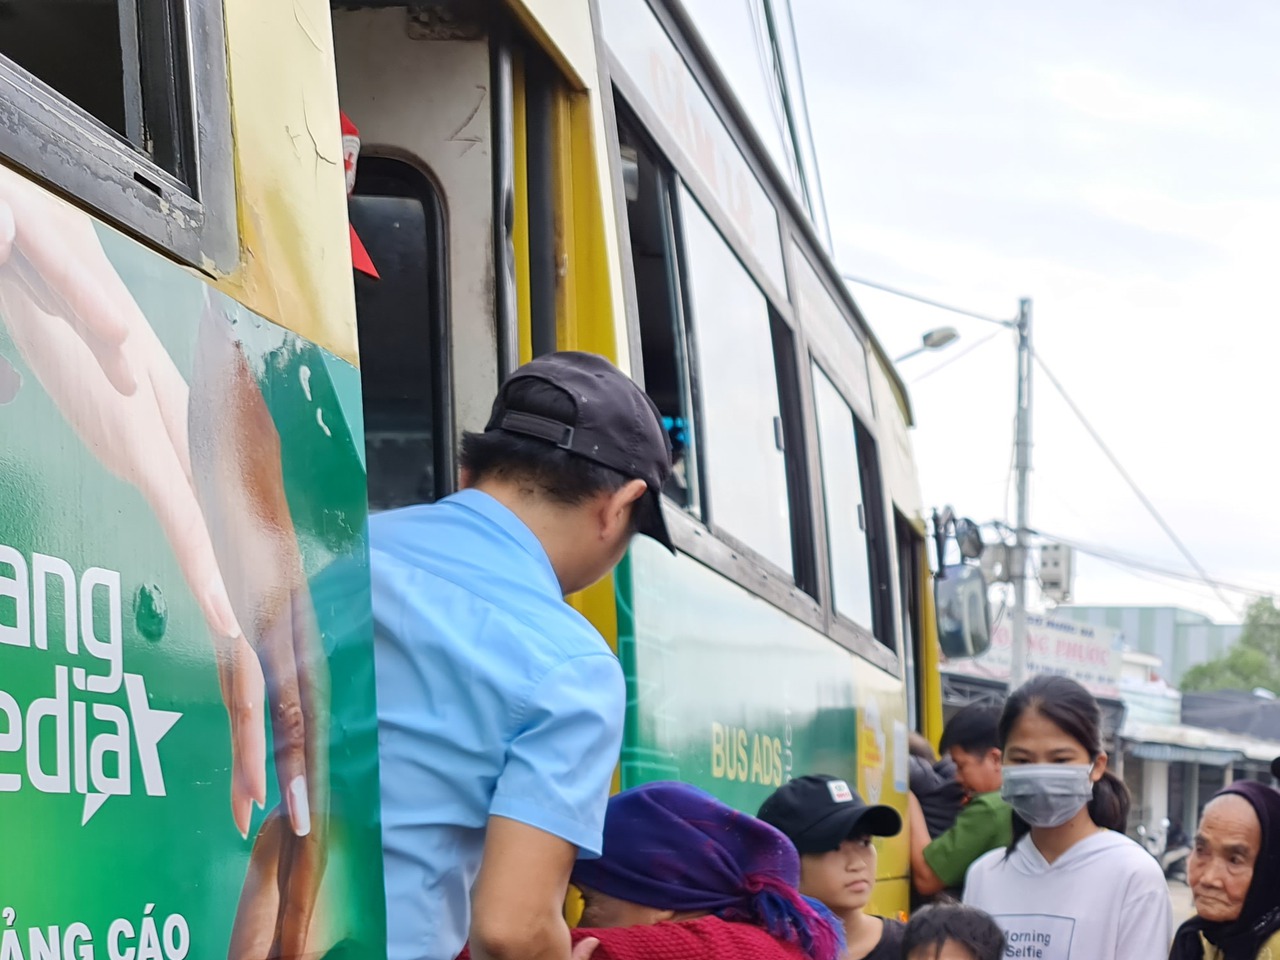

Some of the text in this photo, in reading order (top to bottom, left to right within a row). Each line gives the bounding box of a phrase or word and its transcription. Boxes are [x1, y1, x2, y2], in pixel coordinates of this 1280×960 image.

[712, 722, 748, 782] BUS
[751, 732, 783, 788] ADS
[1004, 944, 1043, 959] Selfie
